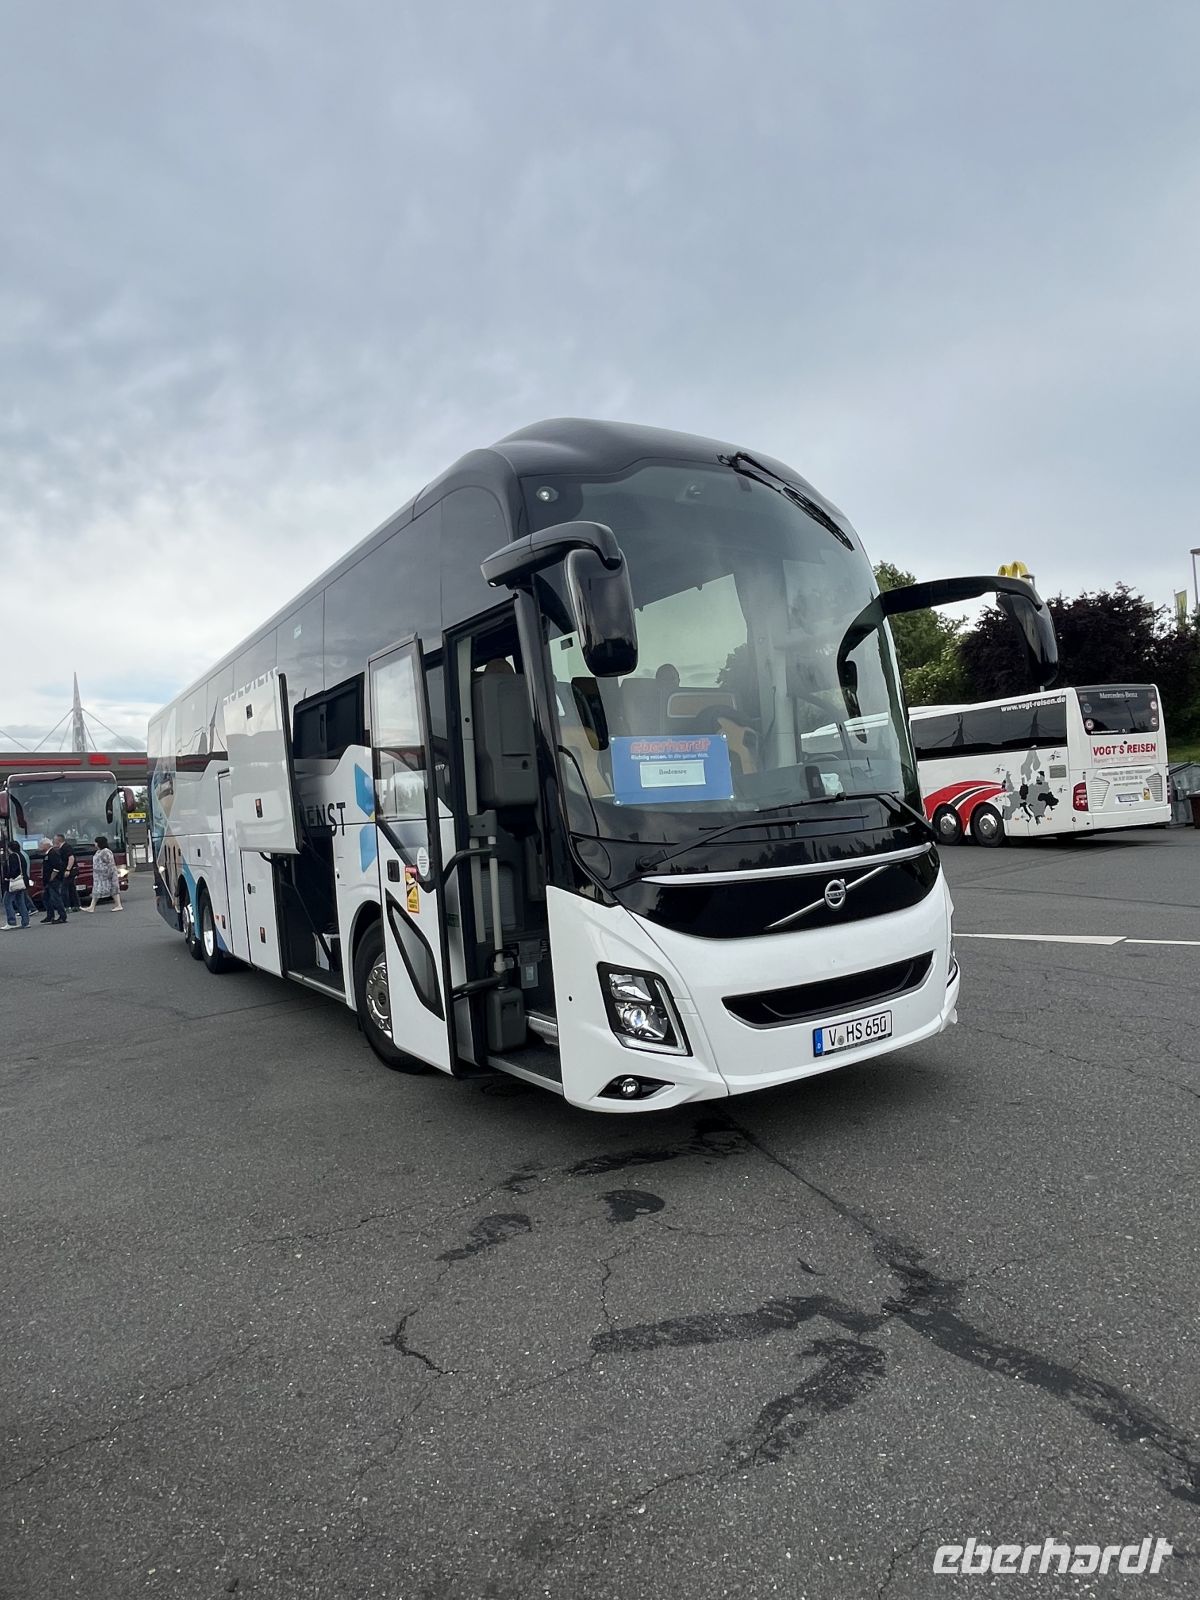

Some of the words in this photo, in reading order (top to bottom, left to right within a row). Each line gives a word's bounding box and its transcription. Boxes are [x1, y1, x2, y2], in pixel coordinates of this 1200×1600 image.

[1000, 696, 1066, 712] www.vogt-reisen.de
[1127, 742, 1157, 754] REISEN
[829, 1028, 837, 1046] V
[846, 1022, 863, 1042] HS
[865, 1015, 887, 1037] 650
